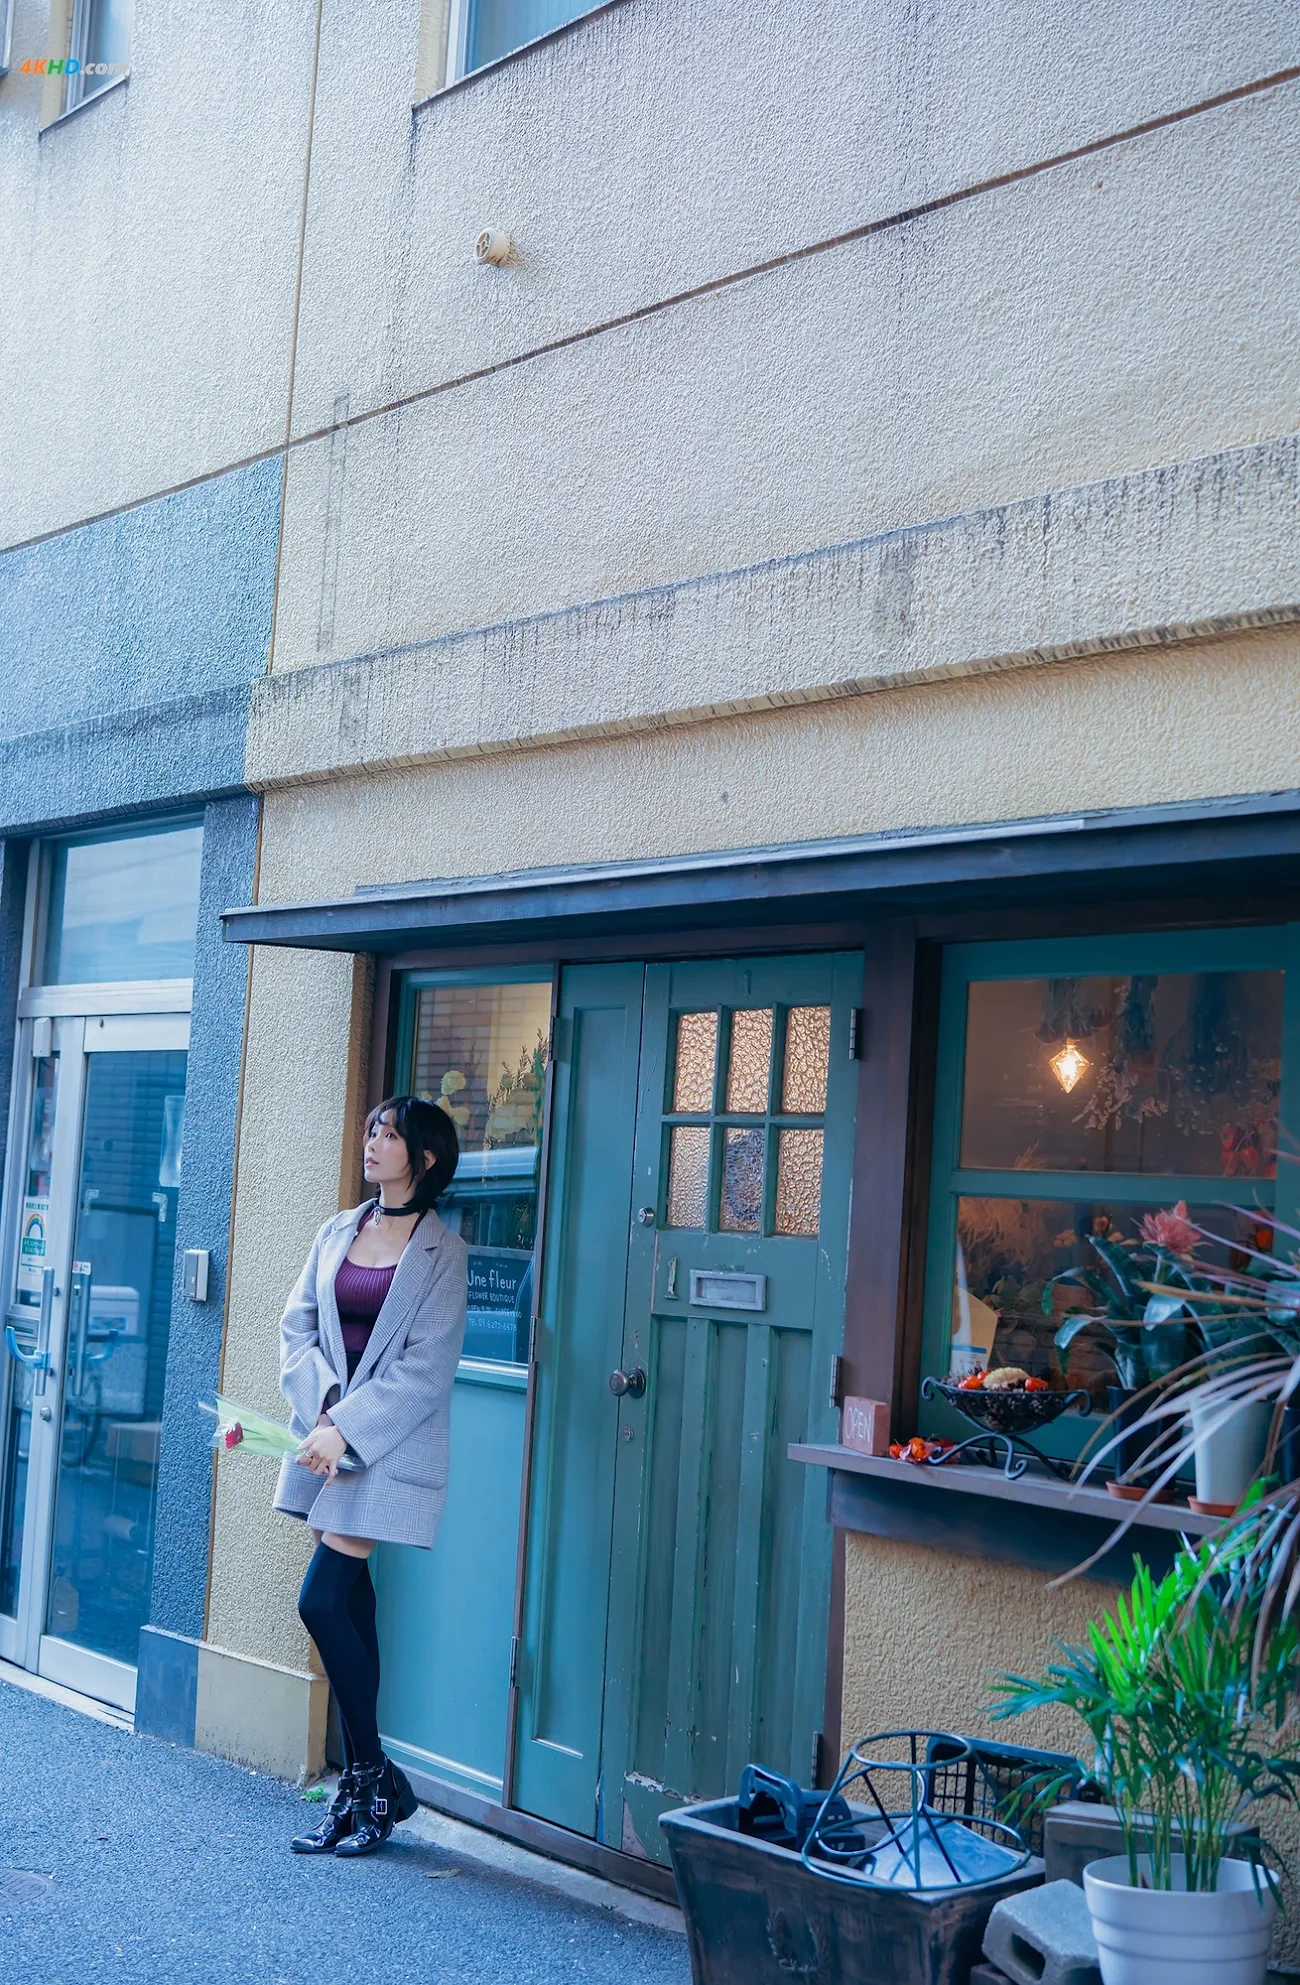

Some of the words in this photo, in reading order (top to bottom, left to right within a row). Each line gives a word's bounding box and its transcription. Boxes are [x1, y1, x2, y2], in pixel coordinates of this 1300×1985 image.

[466, 1270, 487, 1287] Une
[489, 1269, 517, 1290] fleur
[468, 1291, 488, 1300] FLOWER
[489, 1293, 515, 1303] BOUTIQUE
[845, 1406, 872, 1443] OPEN
